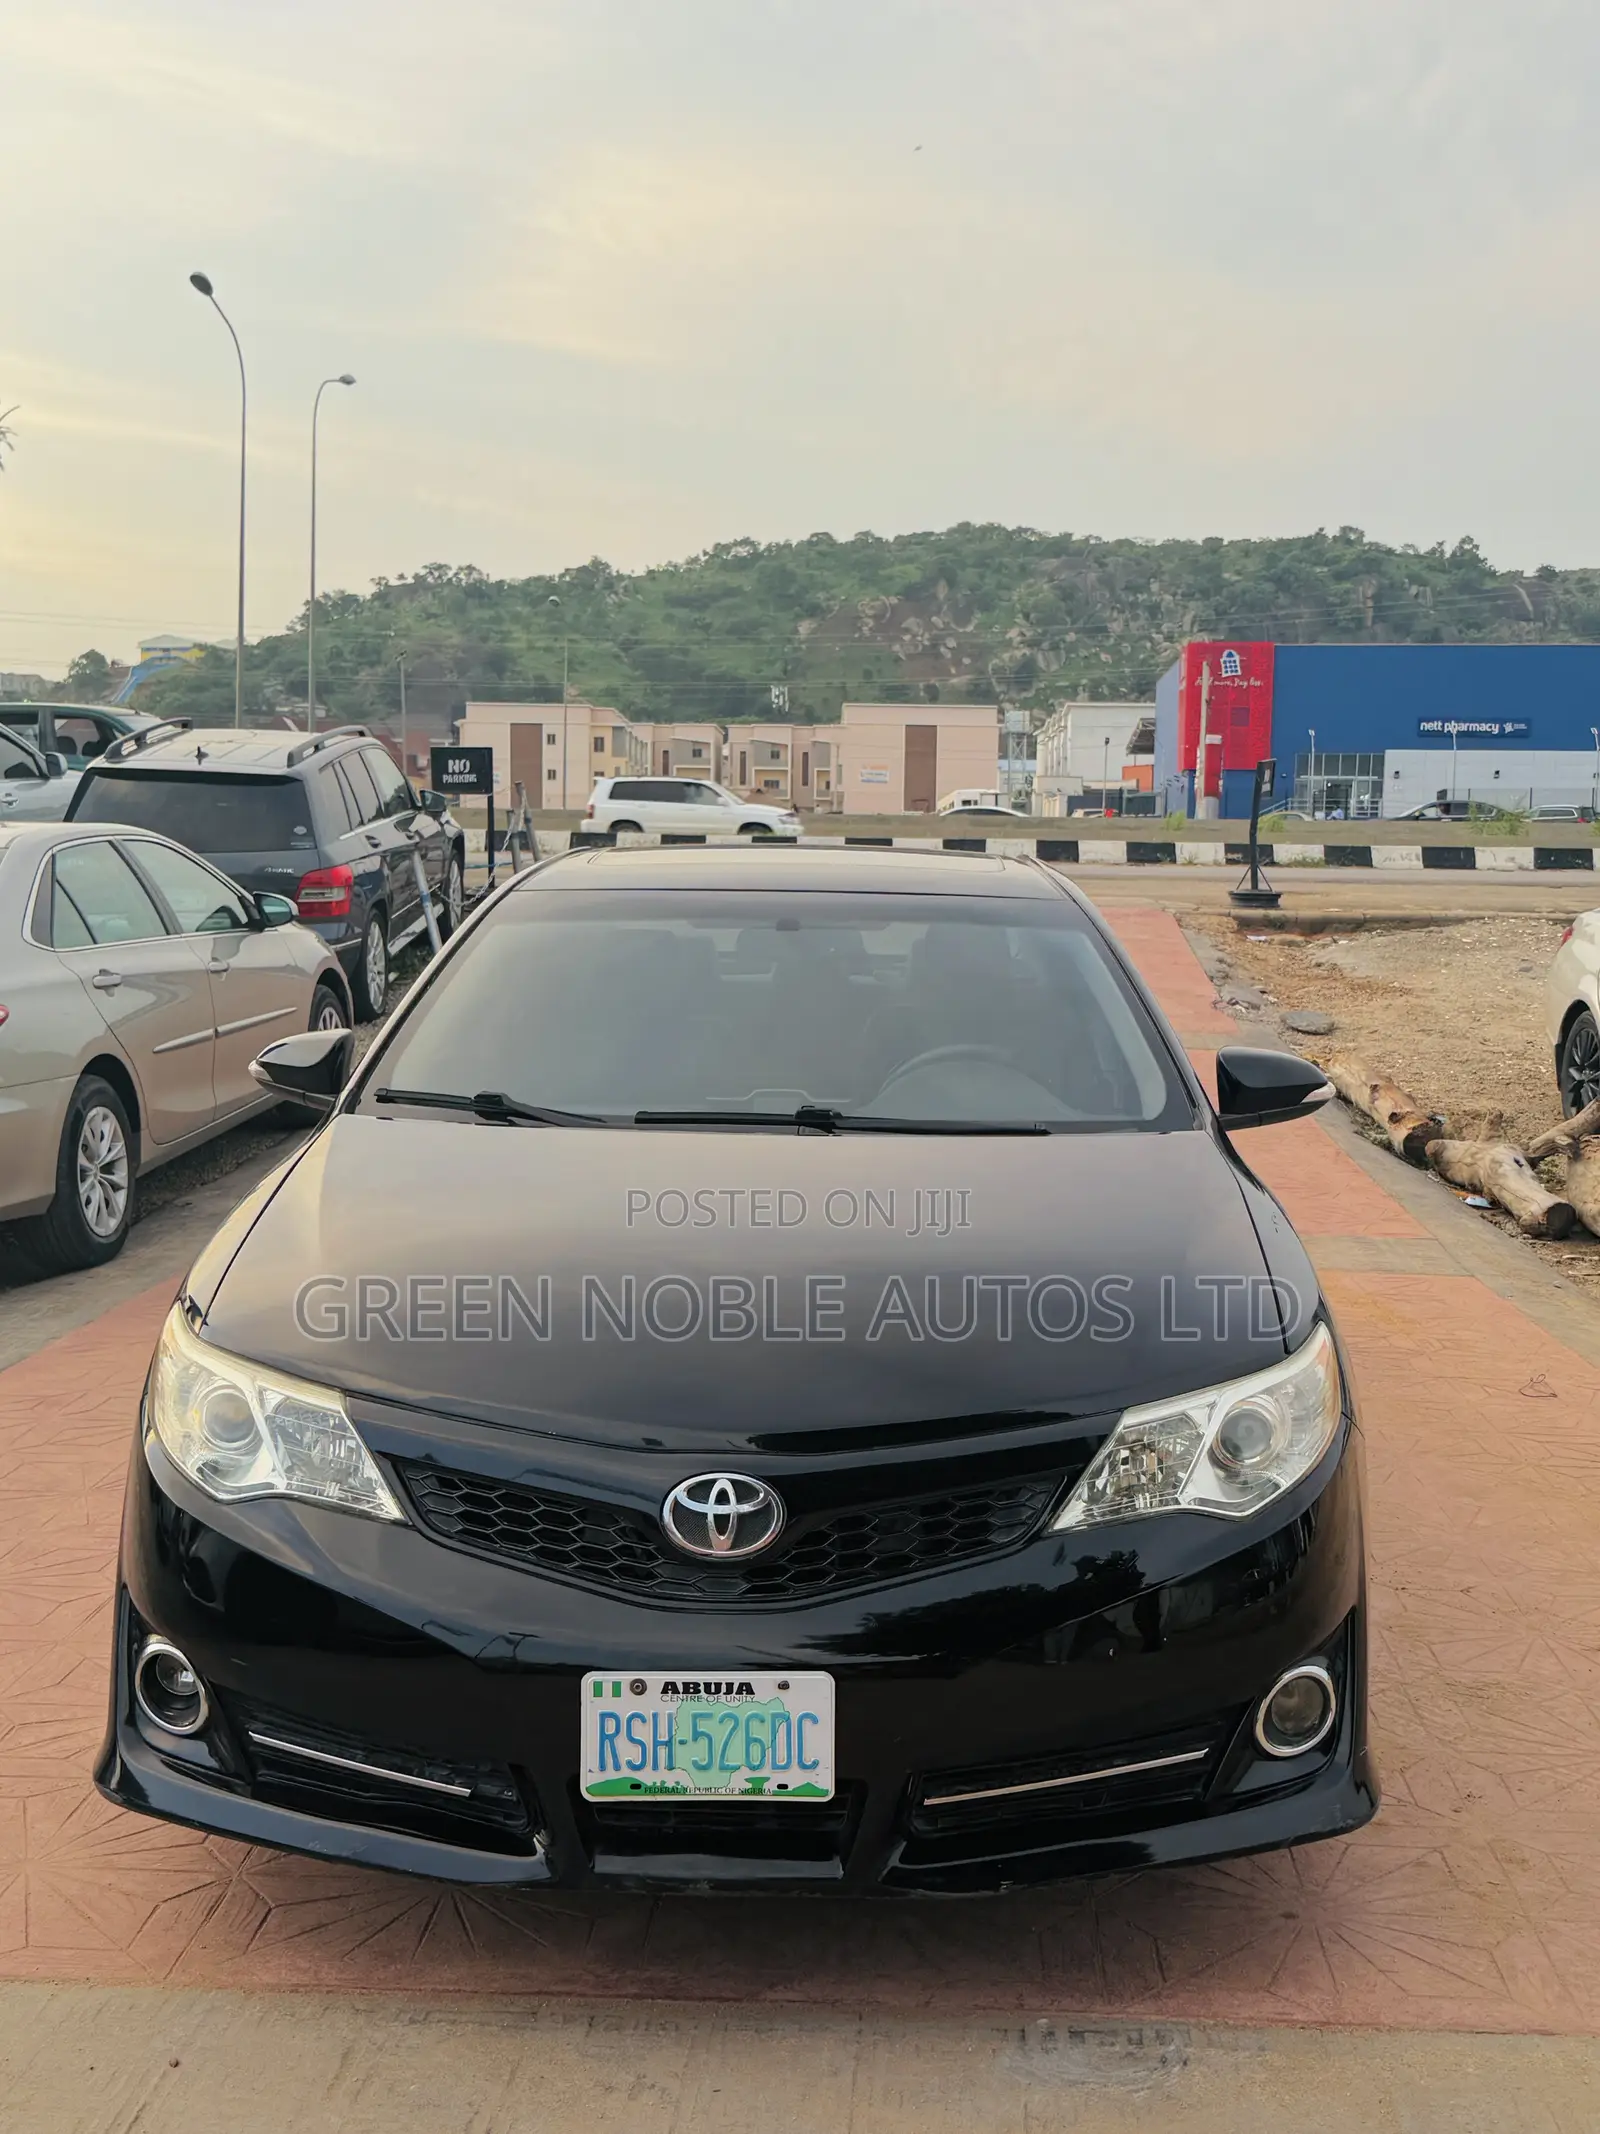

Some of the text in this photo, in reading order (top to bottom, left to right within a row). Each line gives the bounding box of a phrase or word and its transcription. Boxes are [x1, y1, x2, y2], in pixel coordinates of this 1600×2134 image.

[1420, 720, 1442, 731] nett
[1444, 720, 1500, 735] pharmacy
[447, 759, 470, 774] NO
[442, 773, 478, 784] PARKING
[660, 1681, 755, 1696] ABUJA
[660, 1694, 756, 1703] CENTRE OF UNITY
[598, 1711, 819, 1772] RSH-526DC
[644, 1786, 681, 1795] FEDERAL
[724, 1786, 736, 1795] OF
[738, 1786, 772, 1795] NIGERIA
